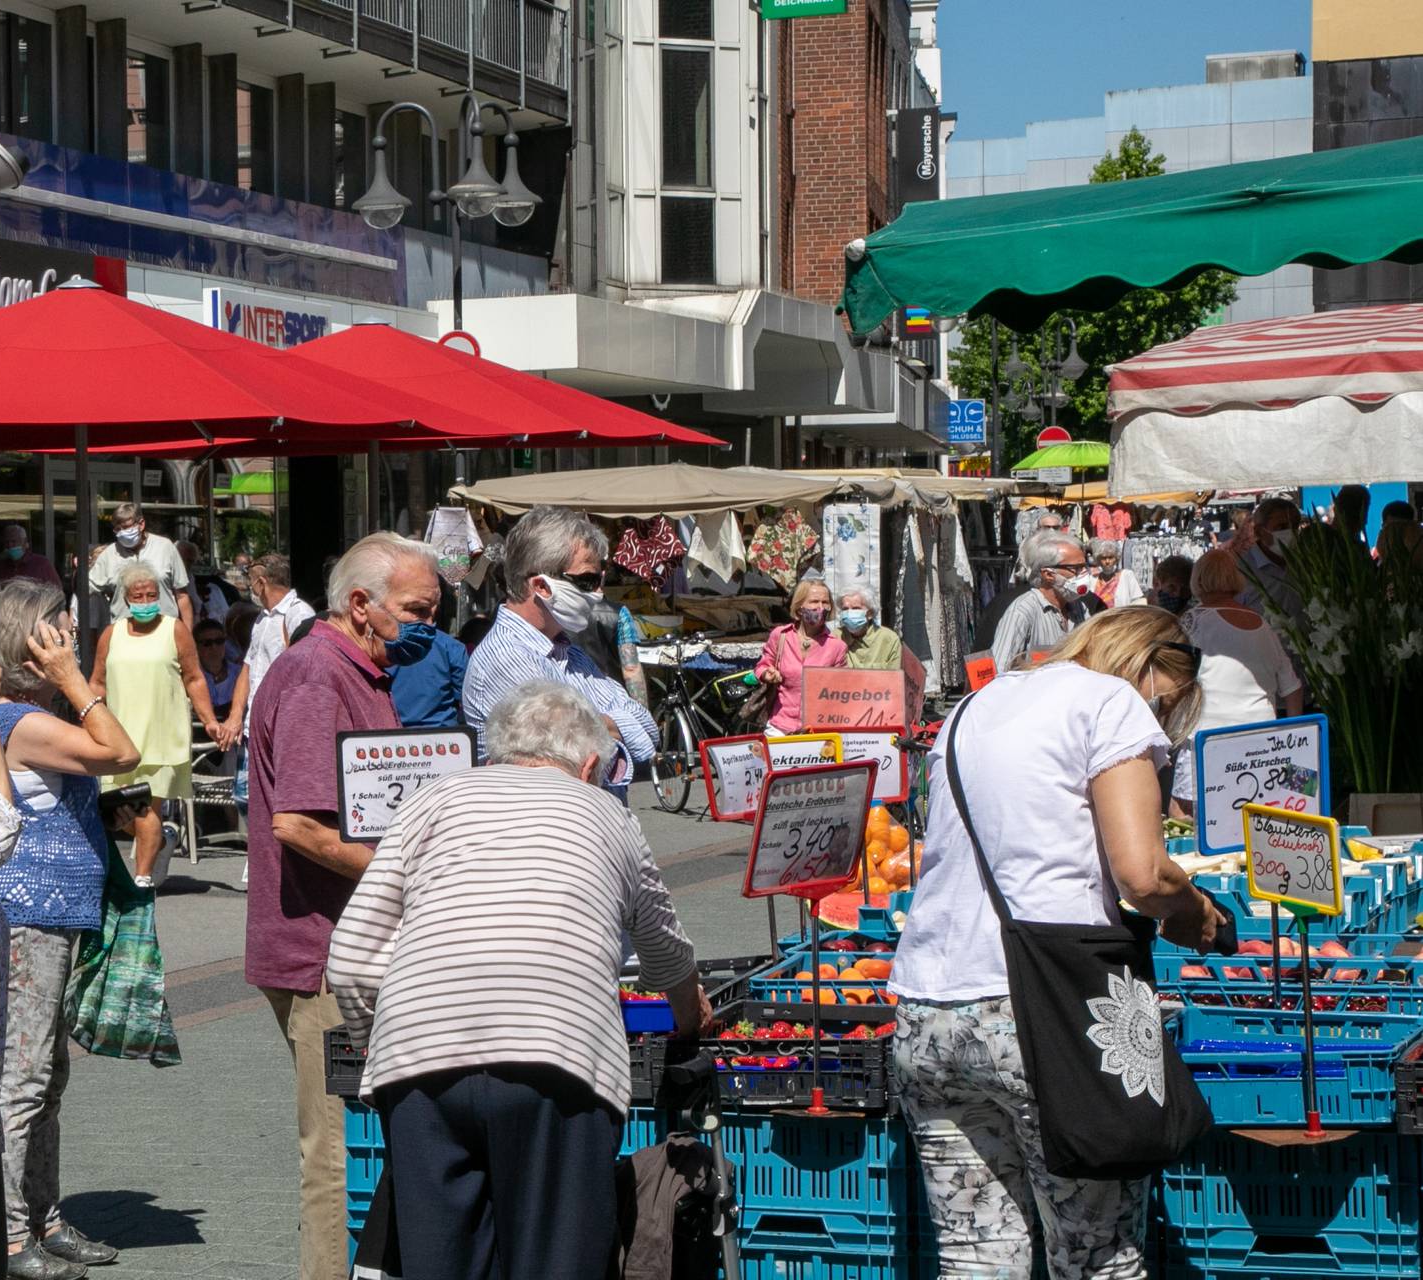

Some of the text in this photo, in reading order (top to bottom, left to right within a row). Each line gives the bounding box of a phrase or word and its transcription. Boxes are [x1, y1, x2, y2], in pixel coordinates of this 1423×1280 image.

[921, 114, 934, 176] Mayersche
[242, 303, 326, 345] INTERSPORT
[818, 687, 892, 702] Angebot
[817, 713, 824, 724] 2
[827, 713, 852, 725] Kilo
[387, 761, 432, 769] Erdbeeren
[721, 752, 755, 767] Aprikosen
[1224, 756, 1291, 773] Süße Kirschen
[377, 772, 440, 783] süß und lecker
[1232, 766, 1288, 810] 2.80
[358, 792, 386, 800] Schale
[766, 795, 846, 811] deutsche Erdbeeren
[352, 825, 358, 833] 2
[772, 816, 833, 830] süß und lecker
[783, 824, 836, 859] 3,40
